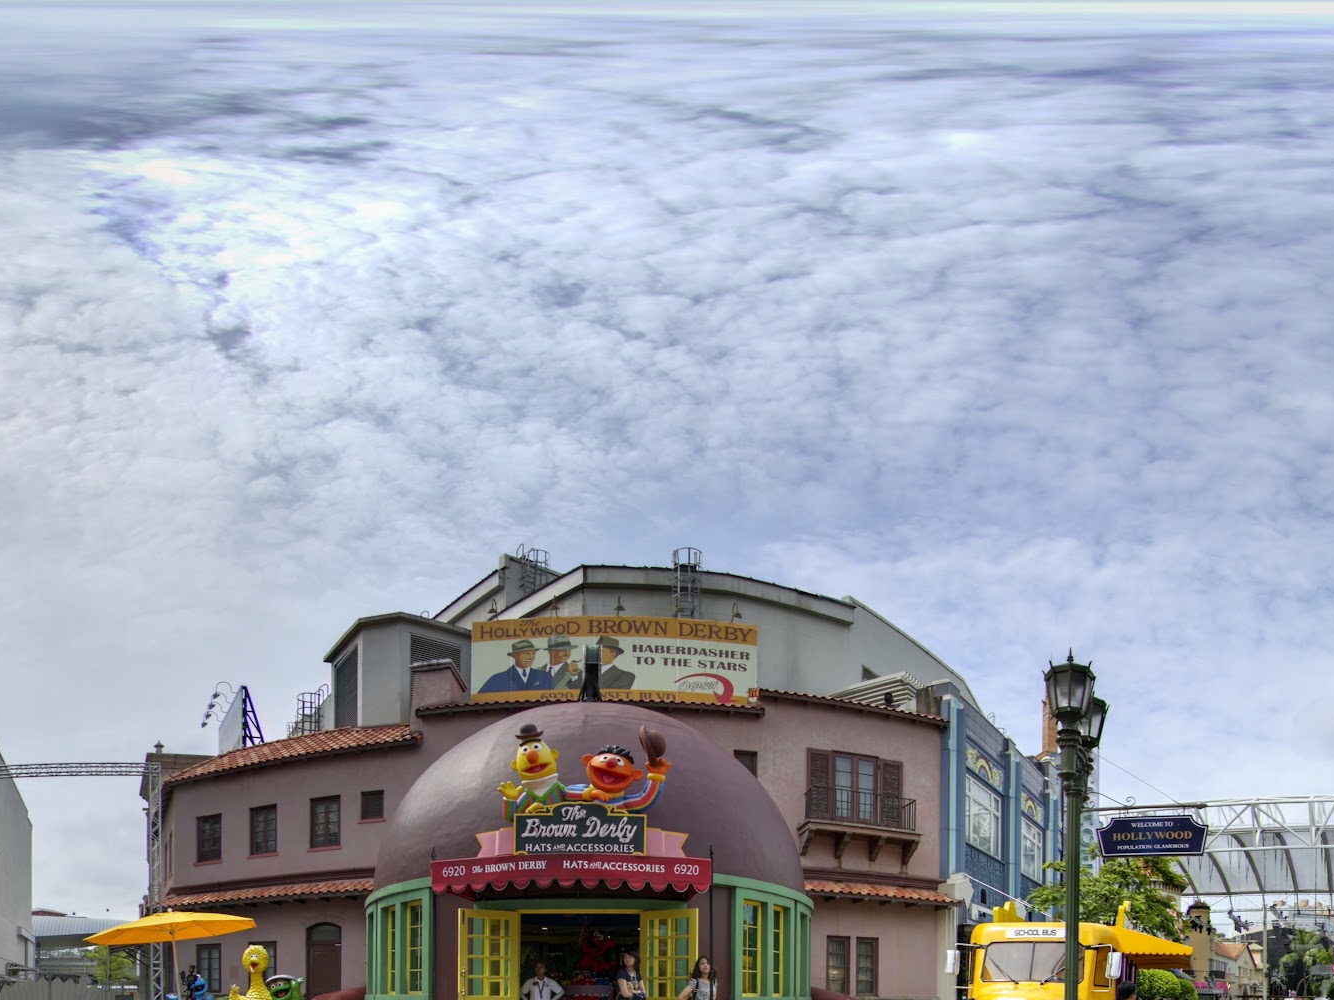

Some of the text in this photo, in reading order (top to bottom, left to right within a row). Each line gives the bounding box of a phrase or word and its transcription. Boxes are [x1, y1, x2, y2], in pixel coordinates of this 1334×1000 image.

[480, 618, 755, 643] HOLLYWOOD BROWN DERBY
[519, 618, 541, 628] The
[632, 644, 751, 661] HABERDASHER
[634, 656, 748, 672] TO THE STARS
[540, 691, 575, 701] 6920
[561, 805, 587, 822] The
[521, 816, 638, 844] Brown Derby
[1112, 831, 1193, 841] HOLLYWOOD
[525, 843, 551, 853] HATS
[566, 843, 634, 853] ACCESSORIES
[442, 865, 466, 877] 6920
[485, 862, 516, 873] BROWN
[518, 860, 547, 871] DERBY
[563, 859, 588, 870] HATS
[589, 861, 602, 869] AND
[602, 862, 665, 873] ACCESSORIES
[673, 864, 699, 876] 6920
[1014, 929, 1040, 937] SCHOOL
